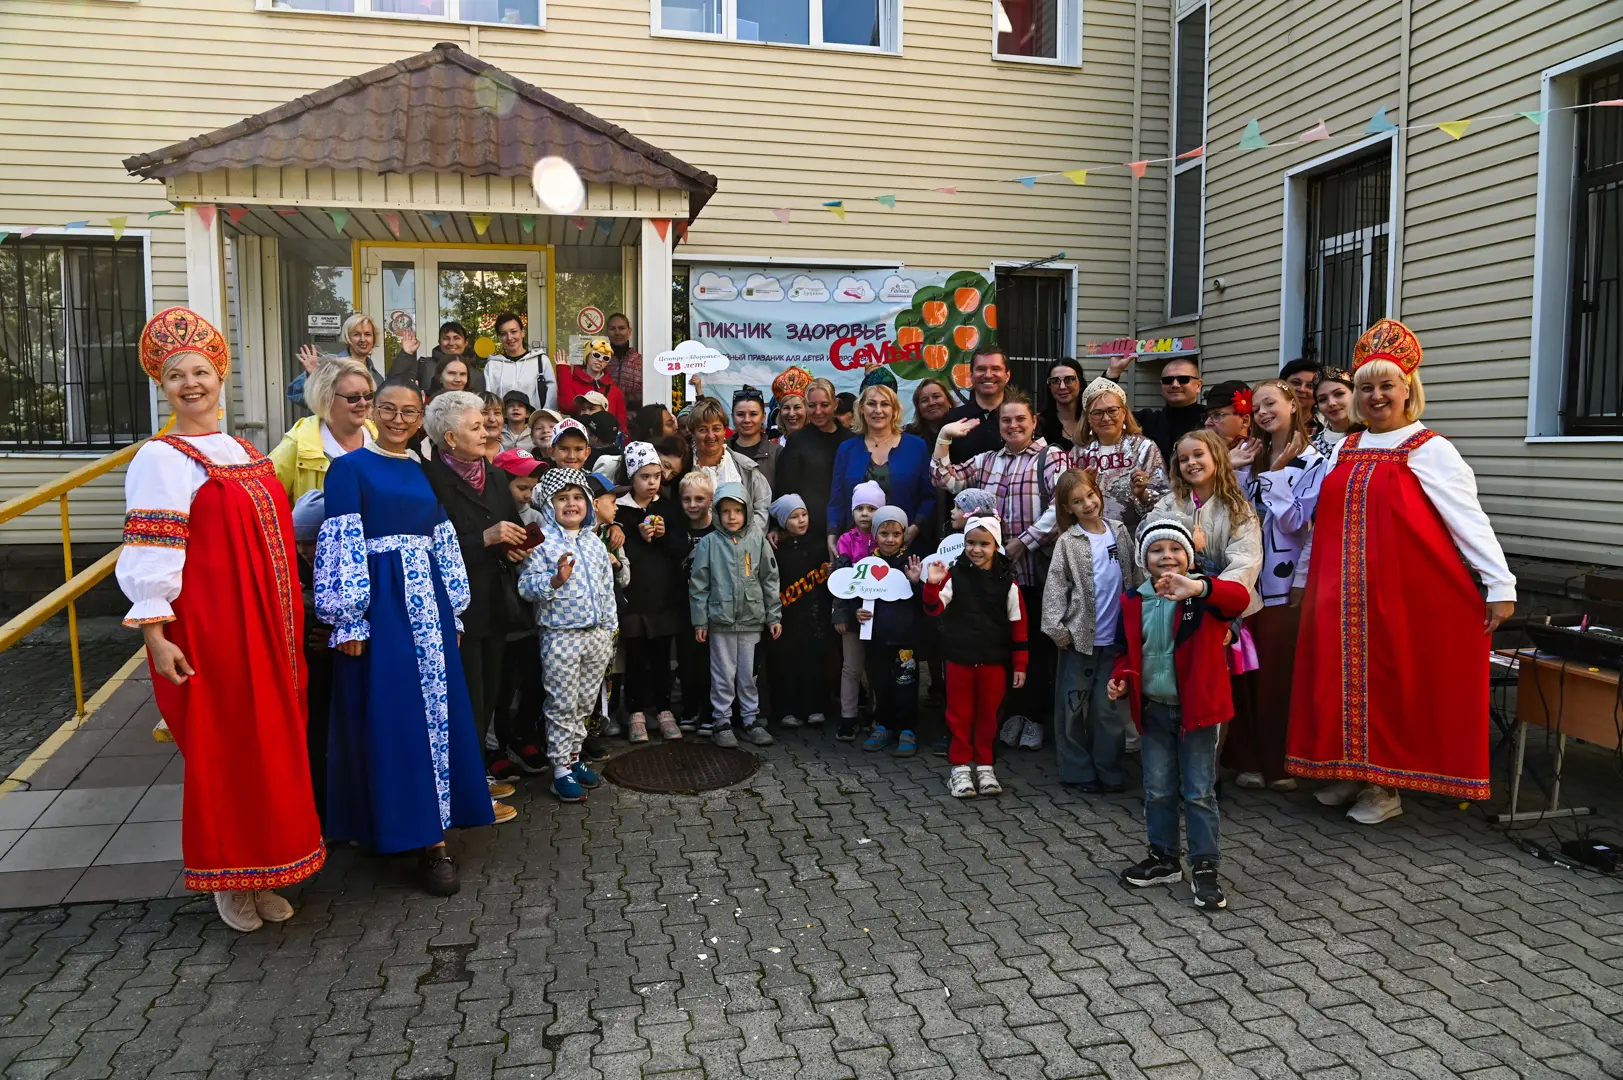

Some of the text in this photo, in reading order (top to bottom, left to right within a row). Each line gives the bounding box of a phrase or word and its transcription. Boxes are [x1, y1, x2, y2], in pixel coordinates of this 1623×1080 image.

[698, 322, 887, 341] ПИКНИК ЗДОРОВЬЕ
[786, 354, 800, 362] ДЛЯ
[802, 354, 824, 362] ДЕТЕЙ
[667, 361, 706, 371] 28 лет!
[1054, 448, 1133, 473] Любовь
[939, 542, 966, 555] Пикни
[852, 563, 869, 579] Я
[859, 585, 888, 593] Здоровье
